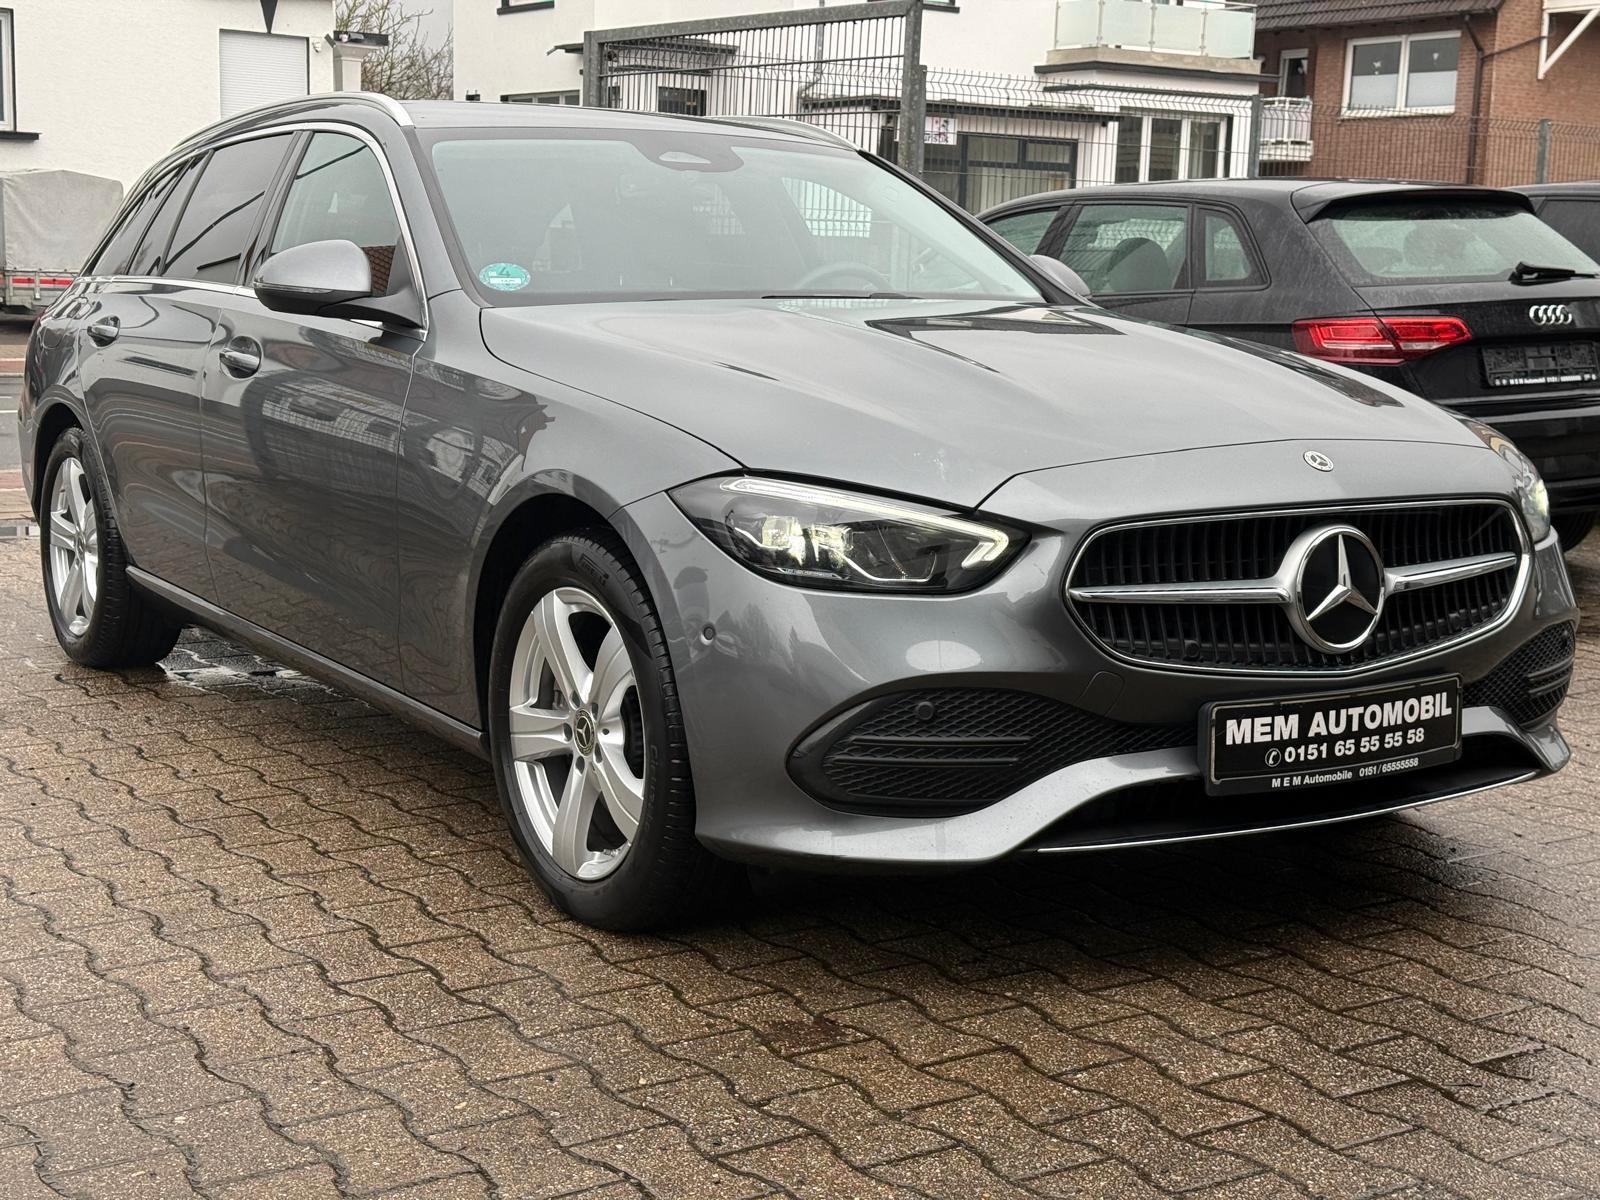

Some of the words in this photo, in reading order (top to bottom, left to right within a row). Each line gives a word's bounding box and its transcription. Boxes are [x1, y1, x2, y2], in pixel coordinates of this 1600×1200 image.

[1226, 714, 1299, 745] MEM
[1308, 692, 1452, 738] AUTOMOBIL
[1284, 743, 1327, 763] 0151
[1334, 740, 1355, 757] 65
[1359, 735, 1380, 753] 55
[1384, 731, 1403, 749] 55
[1406, 727, 1425, 744] 58
[1272, 778, 1281, 788] M
[1283, 777, 1290, 787] E
[1293, 776, 1301, 786] M
[1303, 770, 1352, 785] Automobile
